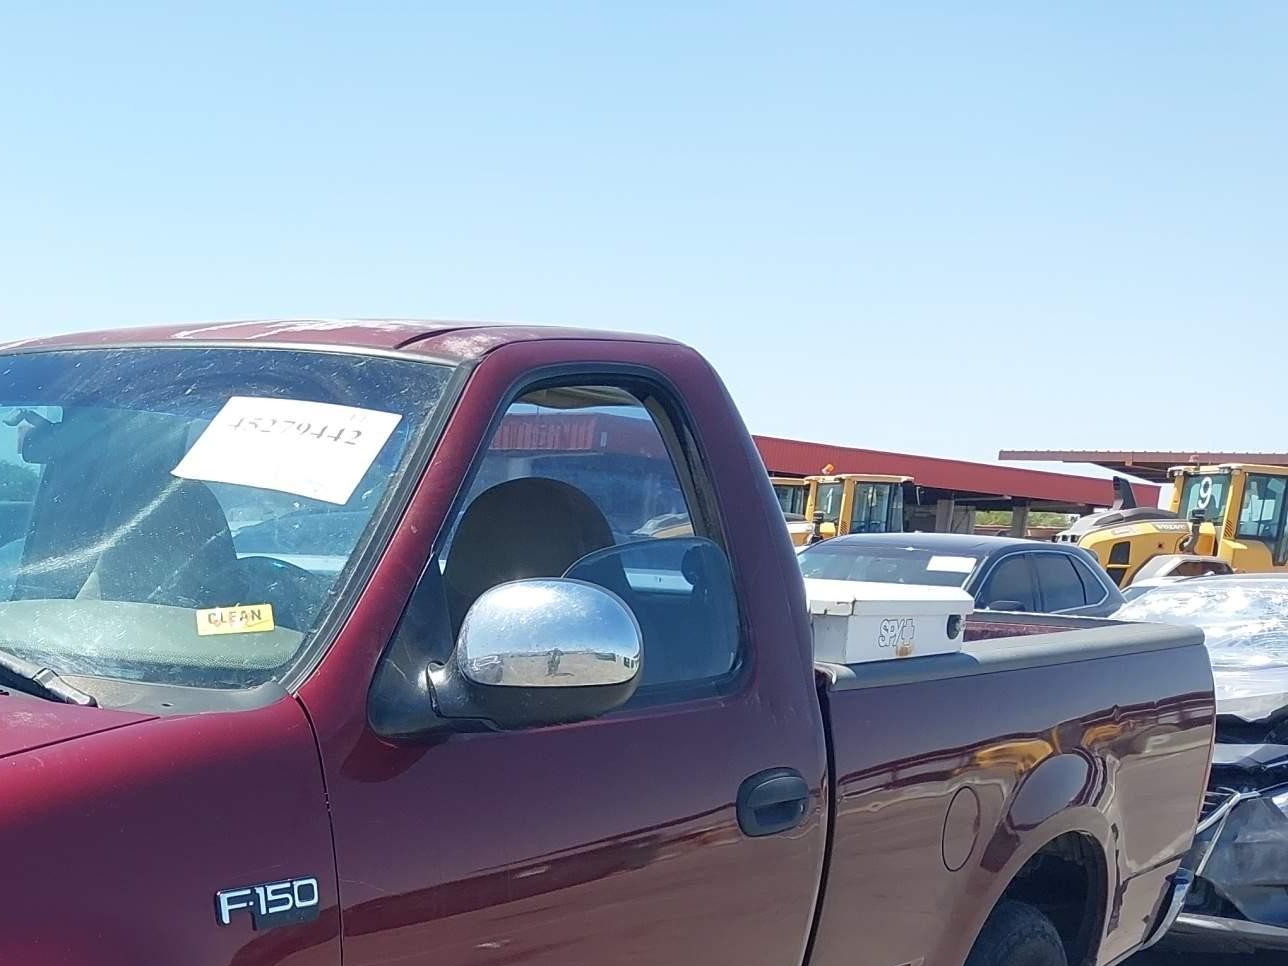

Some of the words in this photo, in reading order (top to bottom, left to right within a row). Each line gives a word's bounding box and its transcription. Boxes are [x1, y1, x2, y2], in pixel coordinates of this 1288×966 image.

[228, 416, 363, 446] 45279442
[827, 487, 834, 514] 1
[1198, 476, 1213, 509] 9
[208, 609, 262, 625] CLEAN
